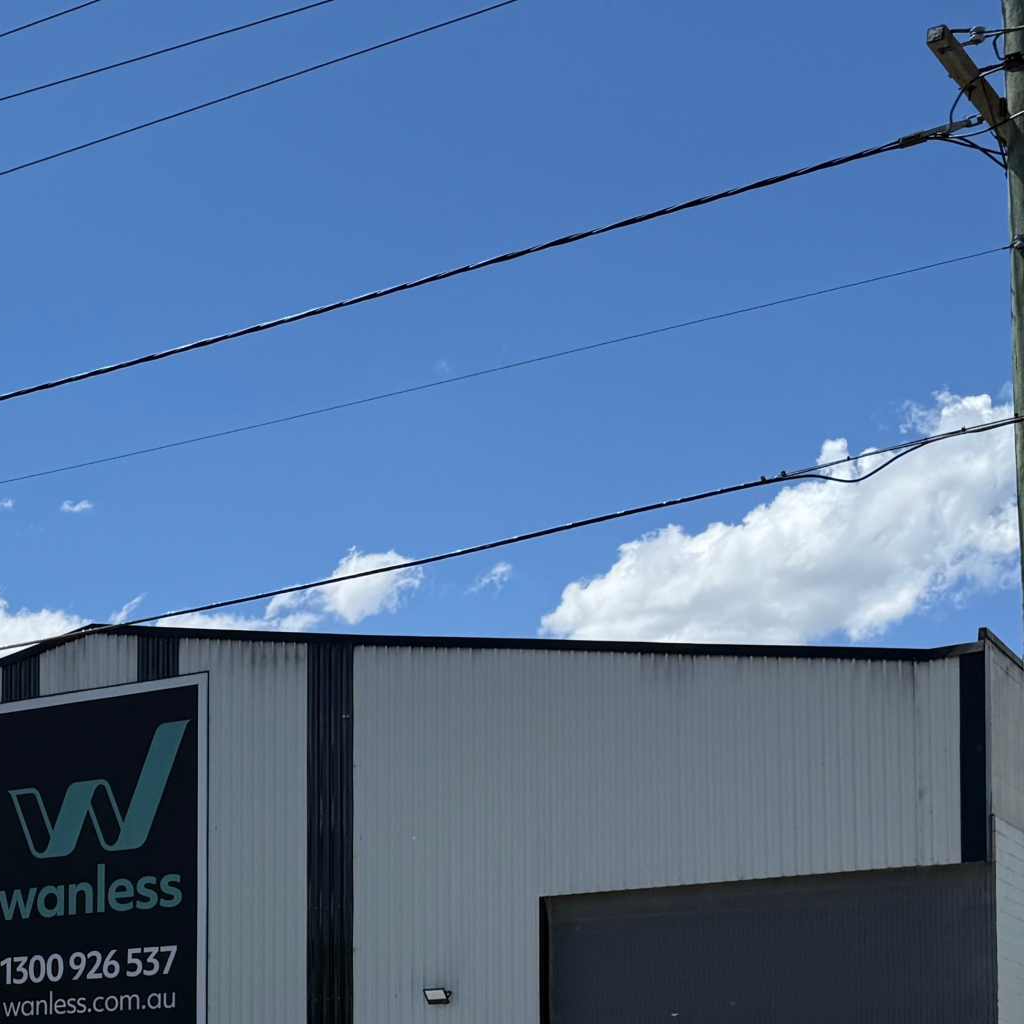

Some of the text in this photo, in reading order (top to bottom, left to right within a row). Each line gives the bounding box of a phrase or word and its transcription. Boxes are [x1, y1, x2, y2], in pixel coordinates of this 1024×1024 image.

[0, 944, 178, 985] 1300 926 537
[2, 990, 176, 1018] wanless.com.au
